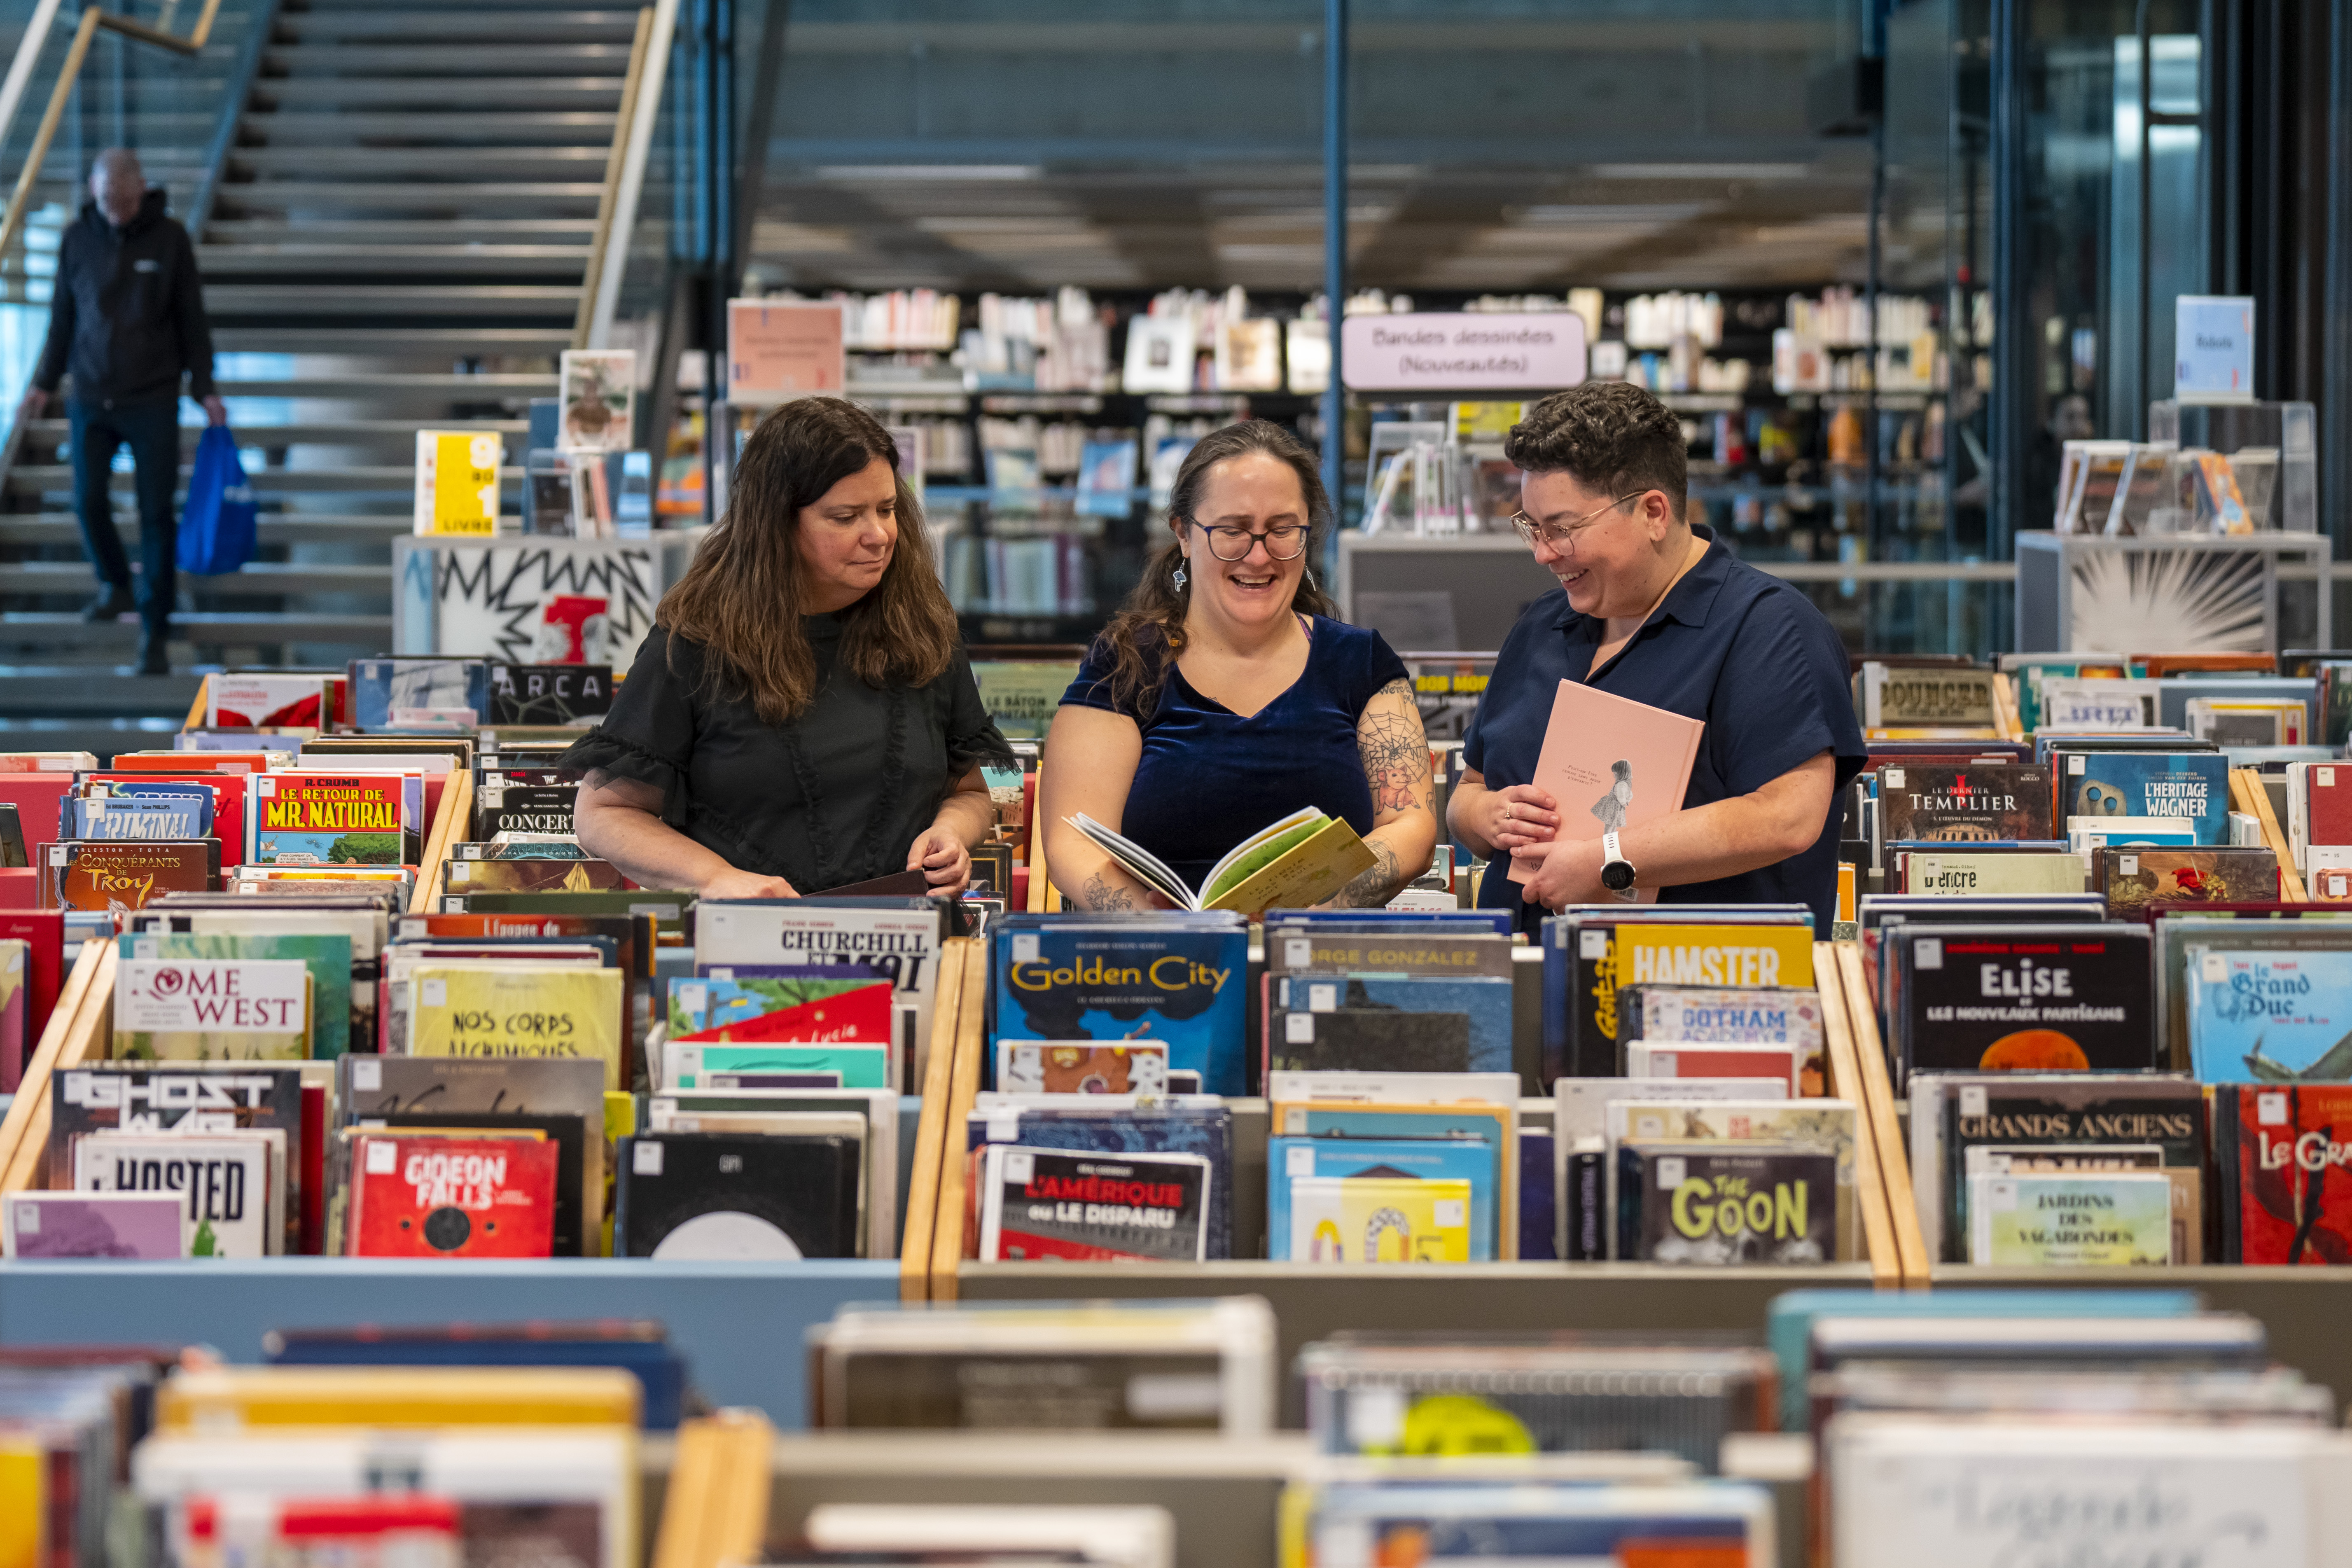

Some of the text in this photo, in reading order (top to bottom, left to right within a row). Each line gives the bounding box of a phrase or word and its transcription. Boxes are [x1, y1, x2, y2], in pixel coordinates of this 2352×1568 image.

[1372, 327, 1554, 346] Bandes dessinées
[1399, 354, 1528, 374] (Nouveautés)
[498, 675, 600, 698] ARCA
[542, 775, 556, 784] THE
[2145, 781, 2207, 798] L'HÉRITAGE
[281, 789, 385, 800] LE RETOUR DE
[1909, 794, 2018, 811] TEMPLIER
[266, 801, 399, 828] MR. NATURAL
[2146, 798, 2207, 817] WAGNER
[86, 813, 190, 838] CRIMINAL
[80, 854, 180, 869] CONQUÉRANTS
[781, 929, 928, 954] CHURCHILL
[1311, 949, 1478, 965] ORGE GONZALEZ
[1633, 944, 1780, 985] HAMSTER
[132, 967, 240, 1002] OME
[1011, 955, 1231, 993] Golden City
[2231, 972, 2311, 995] Grand
[193, 998, 297, 1026] WEST
[1956, 1007, 2039, 1022] NOUVEAUX
[2247, 993, 2294, 1016] Duc
[453, 1010, 573, 1038] NOS CORPS
[1682, 1009, 1786, 1028] GOTHAM
[82, 1075, 274, 1108] GHOST
[1959, 1113, 2193, 1138] GRANDS ANCIENS
[404, 1153, 507, 1187] GIDEON
[91, 1158, 244, 1221] HOSTED
[415, 1180, 493, 1210] FALLS
[1025, 1175, 1183, 1207] L'AMÉRIQUE
[1713, 1174, 1749, 1198] THE
[1671, 1175, 1808, 1241] GOON
[2038, 1194, 2114, 1208] JARDINS
[1056, 1201, 1084, 1223] LE
[1085, 1204, 1177, 1229] DISPARU
[2059, 1213, 2094, 1227] DES
[2019, 1230, 2135, 1245] VAGABONDES
